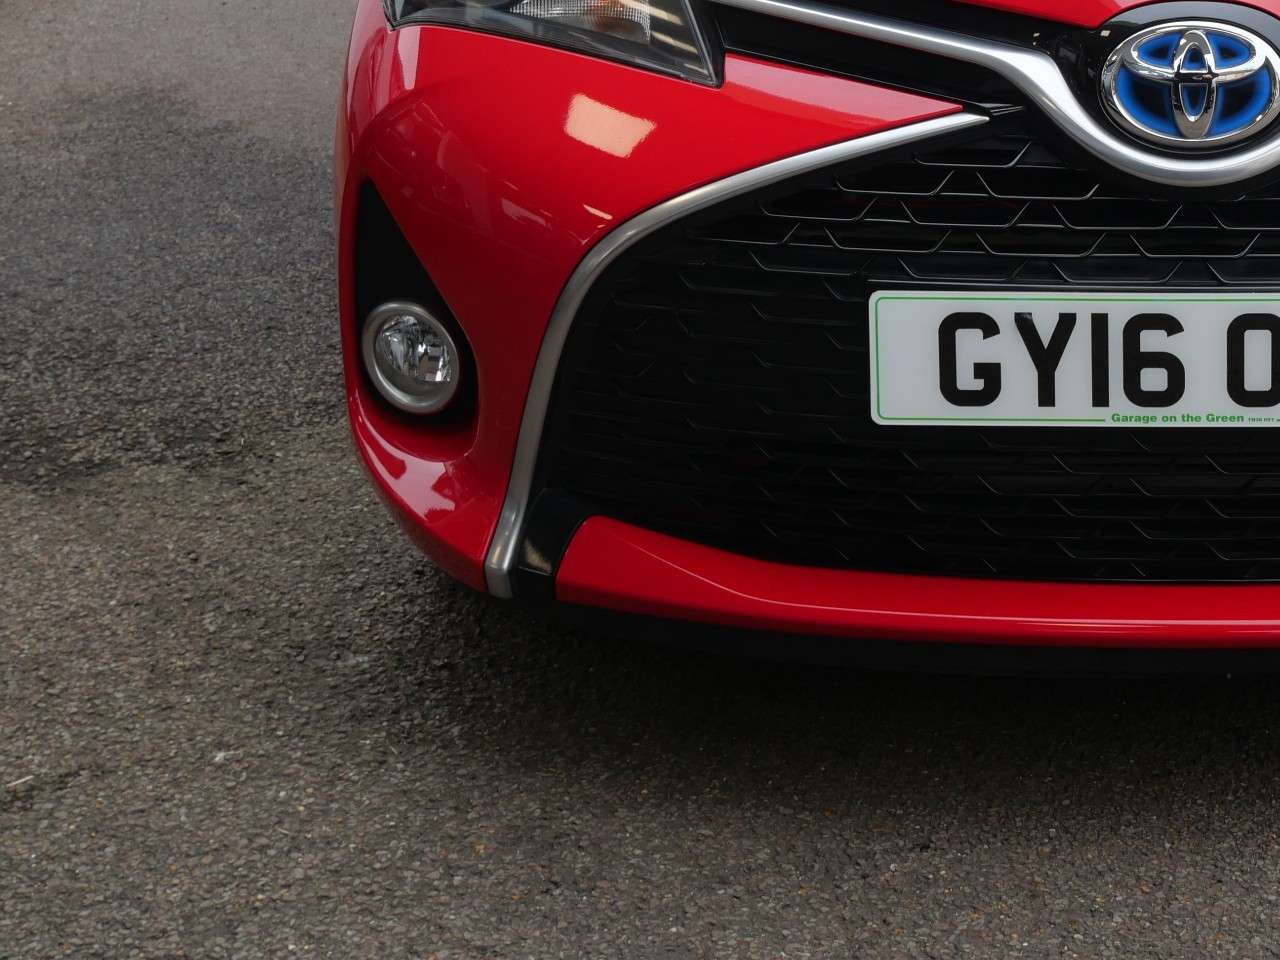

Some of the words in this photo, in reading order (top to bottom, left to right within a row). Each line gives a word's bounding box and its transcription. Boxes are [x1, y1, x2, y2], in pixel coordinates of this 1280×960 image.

[937, 311, 1186, 408] GY16
[1111, 413, 1158, 424] Garage
[1161, 415, 1178, 423] on
[1181, 413, 1202, 423] the
[1205, 413, 1245, 423] Green
